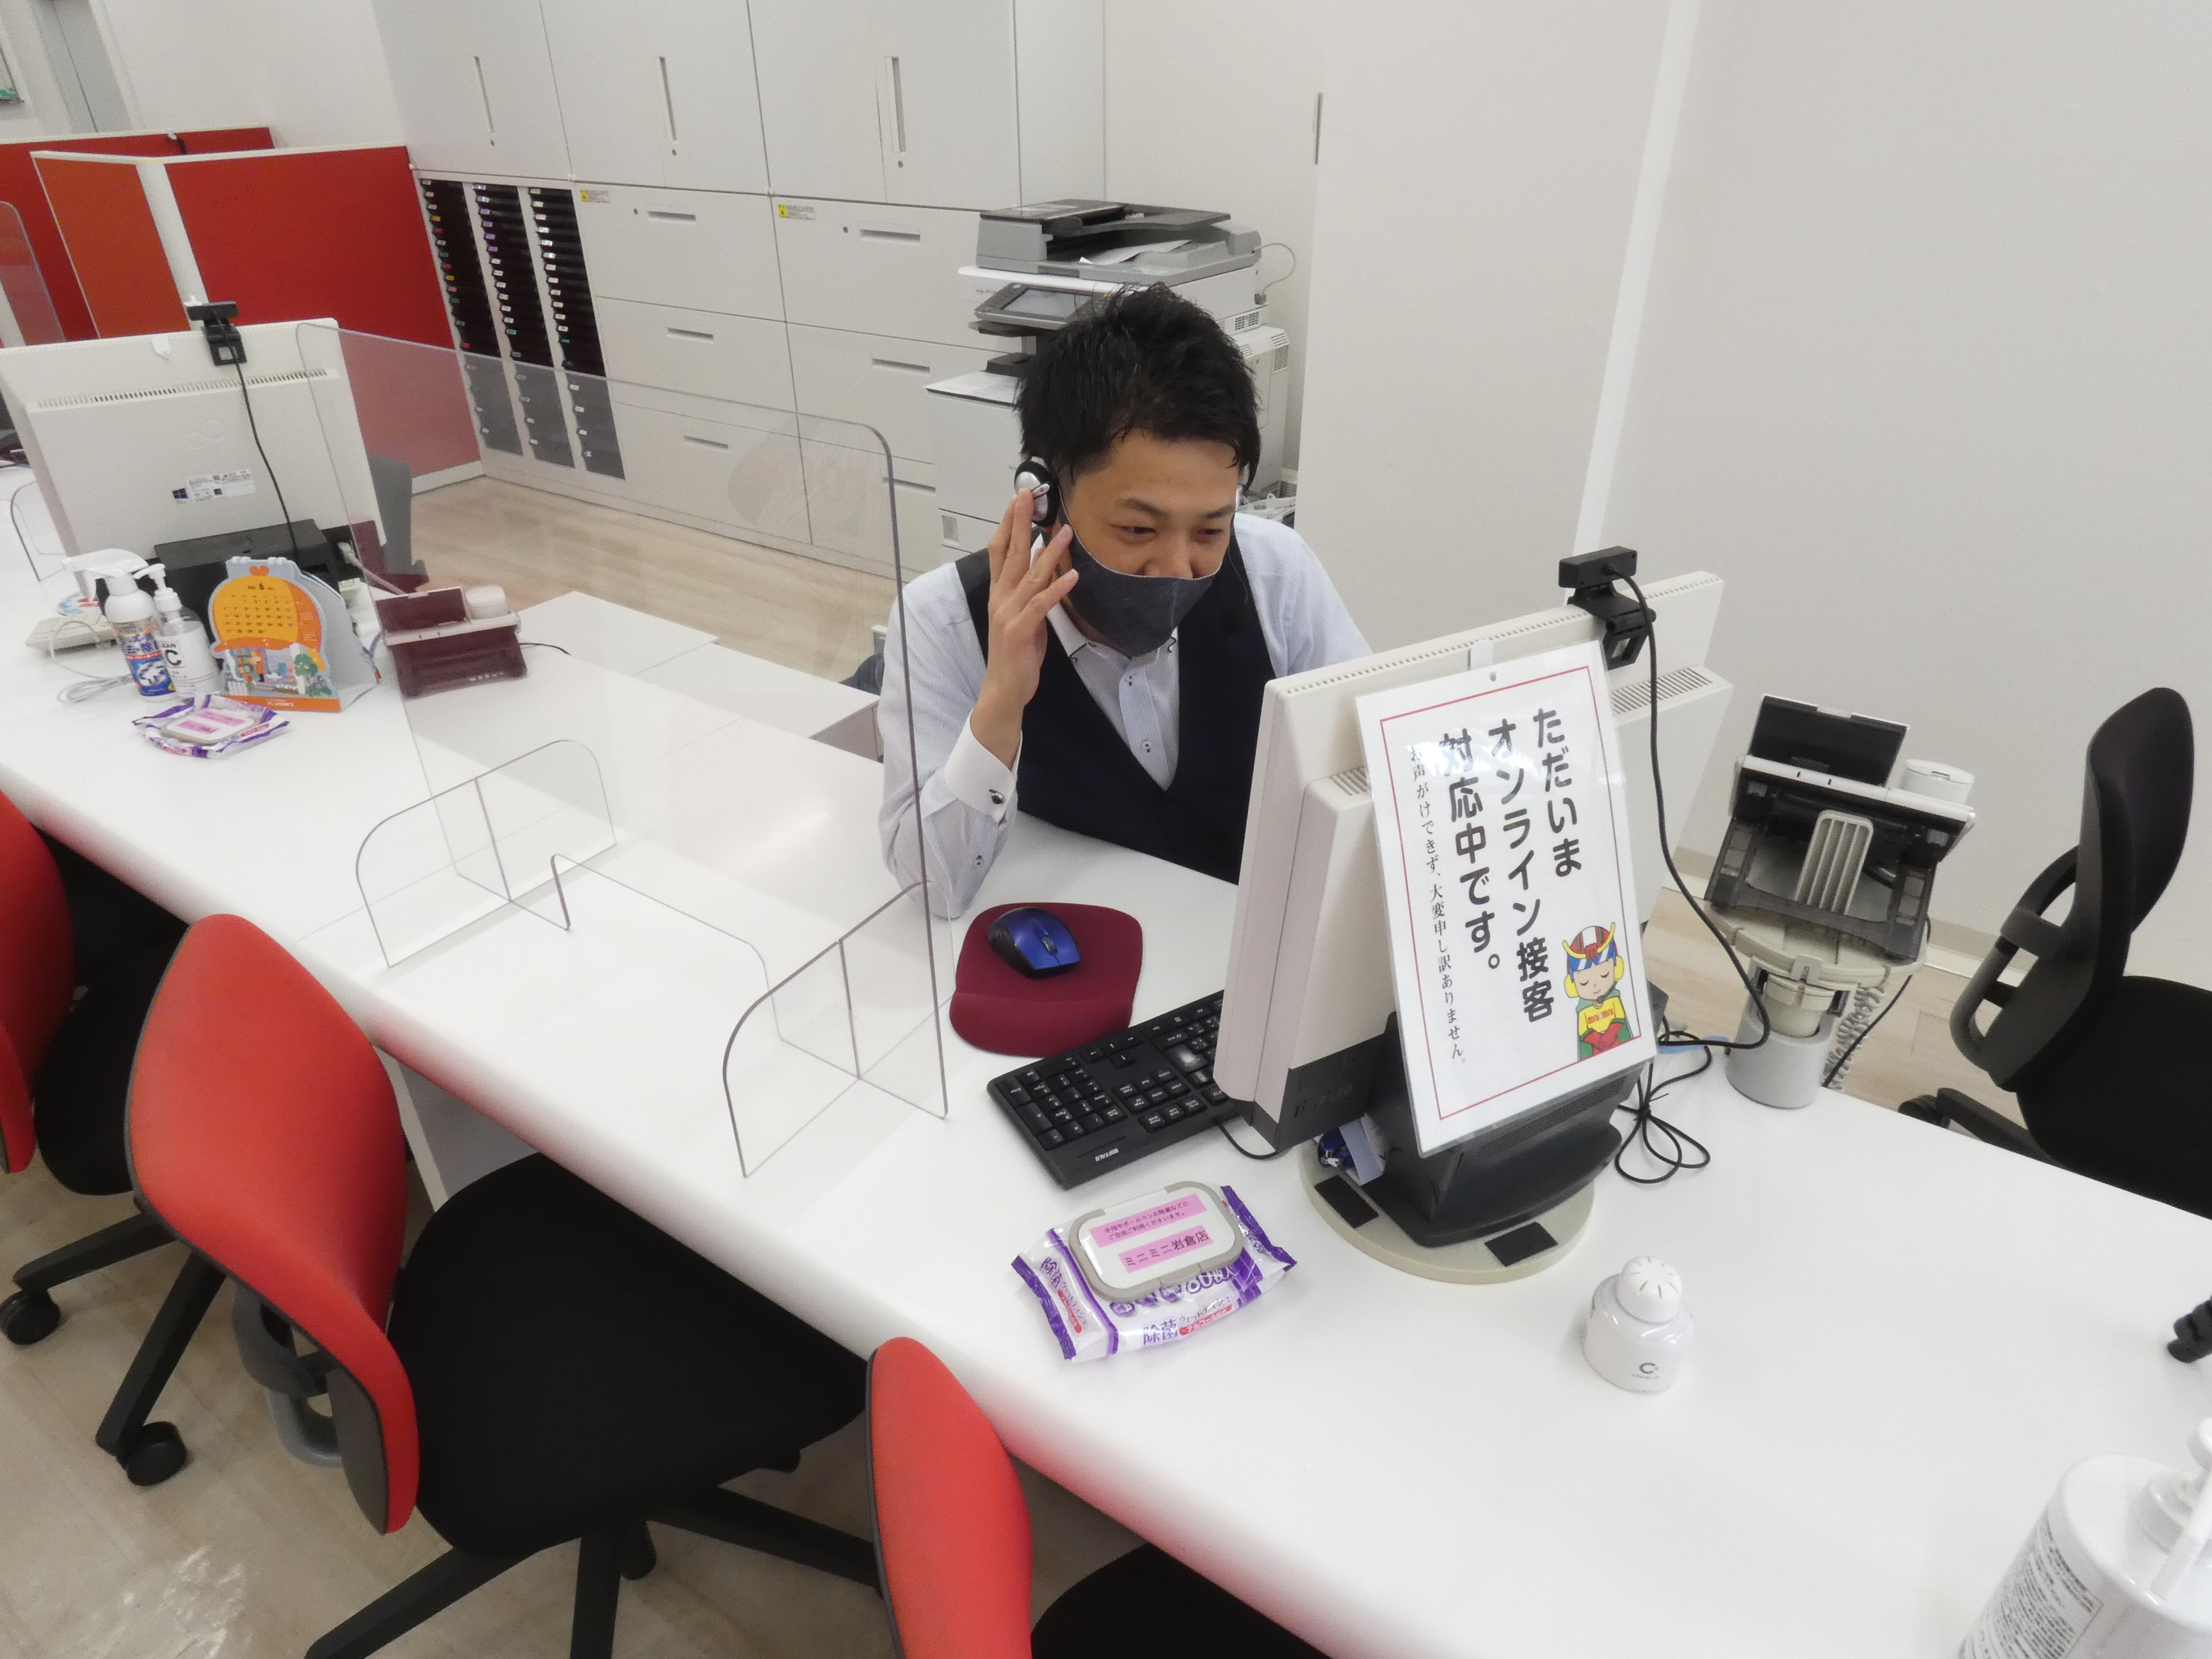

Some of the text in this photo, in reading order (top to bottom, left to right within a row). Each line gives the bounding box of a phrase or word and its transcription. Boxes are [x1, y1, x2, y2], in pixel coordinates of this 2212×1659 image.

[164, 649, 182, 666] C
[1533, 708, 1582, 878] ただいま
[1439, 728, 1501, 970] 対応中です。
[1488, 718, 1555, 1023] オンライン接客
[1409, 746, 1466, 1064] お声がけできず、大変申し訳ありません。
[1094, 1148, 1119, 1162] BUFFALO
[1125, 1230, 1210, 1266] ミニミニ岩倉店
[1039, 1256, 1063, 1289] 除菌
[1142, 1318, 1178, 1345] 除菌
